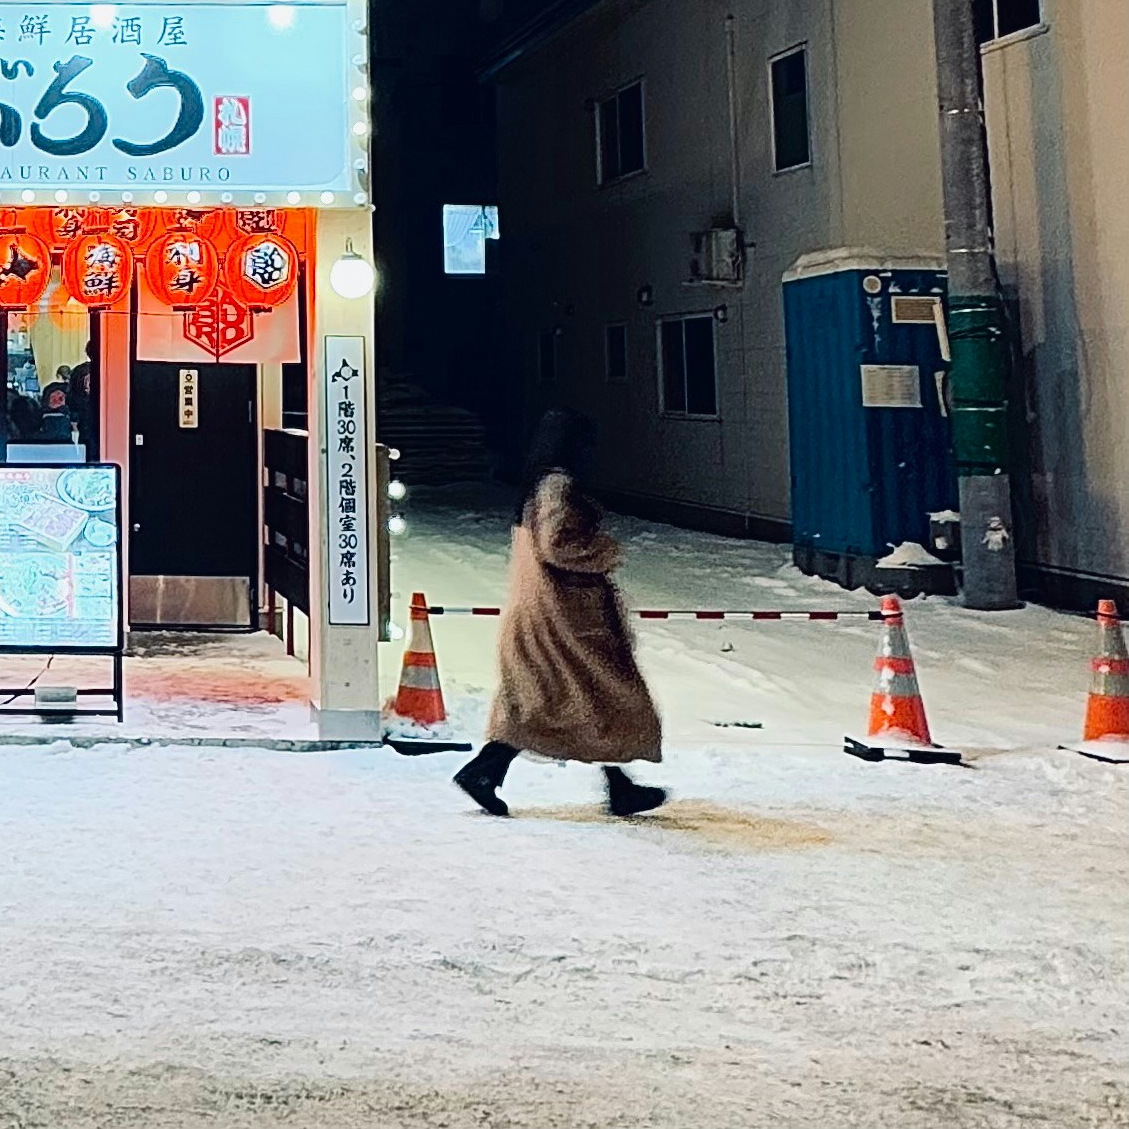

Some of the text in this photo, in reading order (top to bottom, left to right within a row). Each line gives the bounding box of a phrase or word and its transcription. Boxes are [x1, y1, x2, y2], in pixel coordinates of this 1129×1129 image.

[128, 164, 232, 183] SABURO
[83, 242, 119, 296] 海鮮
[169, 241, 203, 293] 刺身
